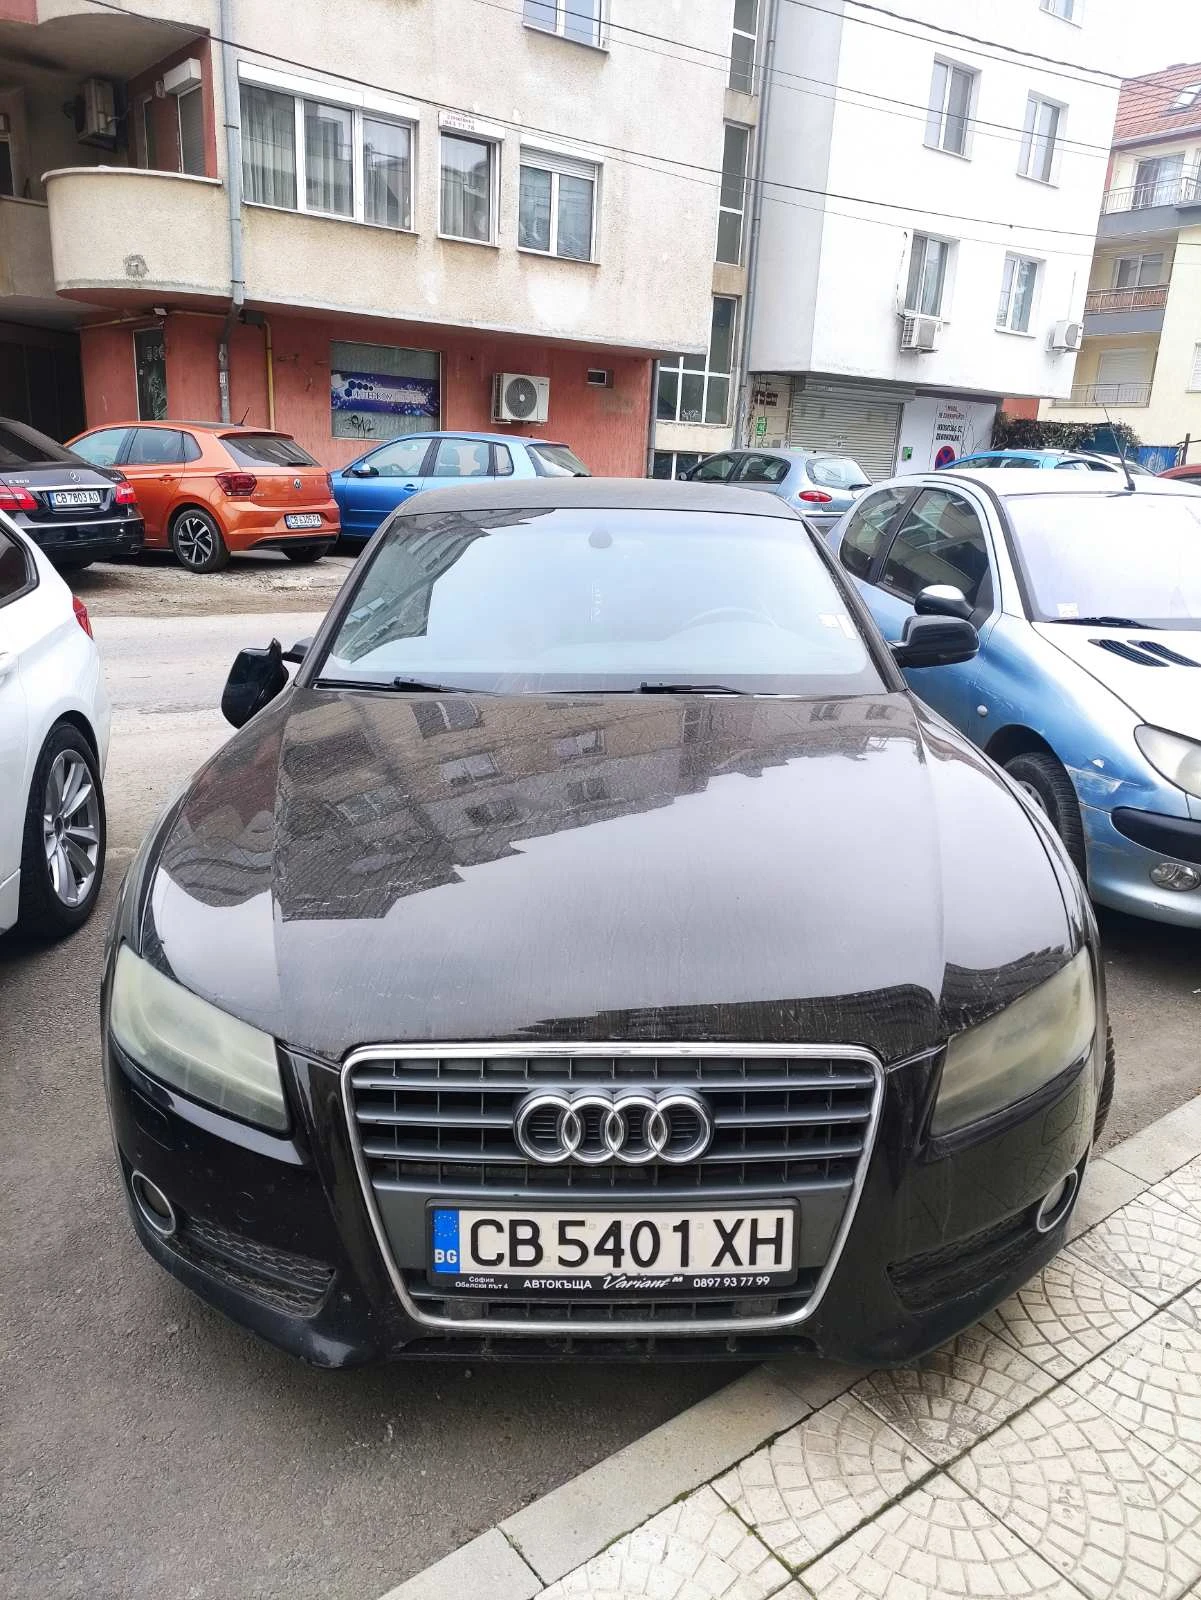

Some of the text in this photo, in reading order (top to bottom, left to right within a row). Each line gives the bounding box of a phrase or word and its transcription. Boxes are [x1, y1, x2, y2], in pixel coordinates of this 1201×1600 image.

[56, 492, 67, 503] CB
[470, 1217, 784, 1268] CB 5401 XH
[434, 1249, 458, 1263] BG
[523, 1279, 593, 1291] АВТОКЪЩА
[601, 1275, 673, 1290] Variant
[693, 1276, 770, 1288] 0897 93 77 99
